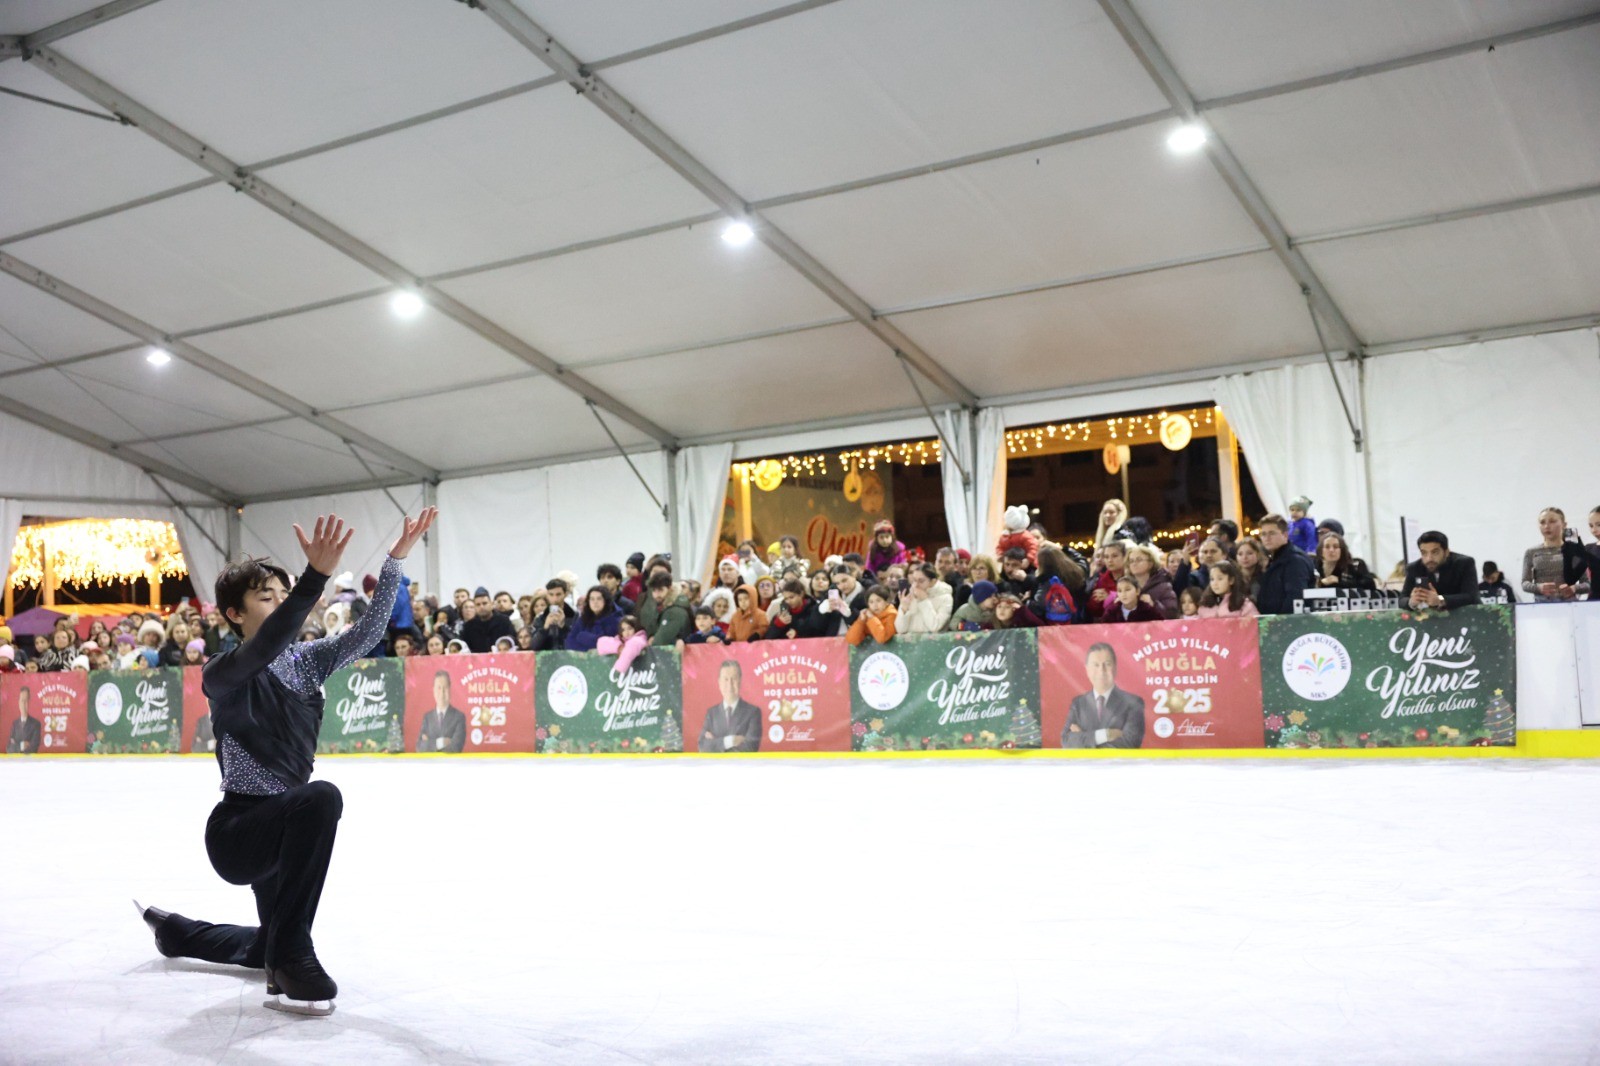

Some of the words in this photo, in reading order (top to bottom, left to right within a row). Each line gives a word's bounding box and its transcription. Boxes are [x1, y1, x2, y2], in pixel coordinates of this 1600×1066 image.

[1132, 638, 1177, 661] MUTLU
[1180, 637, 1230, 659] YILLAR
[1388, 626, 1476, 678] Yeni
[753, 655, 788, 677] MUTLU
[789, 655, 828, 674] YILLAR
[945, 645, 1009, 689] Yeni
[1145, 652, 1217, 672] MUĞLA
[460, 668, 488, 685] MUTLU
[489, 667, 519, 684] YILLAR
[468, 679, 510, 693] MUĞLA
[609, 662, 659, 700] Yeni
[763, 668, 817, 685] MUĞLA
[1146, 676, 1170, 687] HOŞ
[1173, 673, 1219, 685] GELDİN
[763, 689, 782, 698] HOŞ
[926, 678, 1010, 725] Yılınız
[1365, 663, 1481, 719] Yılınız
[949, 704, 980, 723] kutlu
[980, 701, 1007, 719] olsun
[1396, 694, 1437, 717] kutlu
[1437, 691, 1478, 712] olsun
